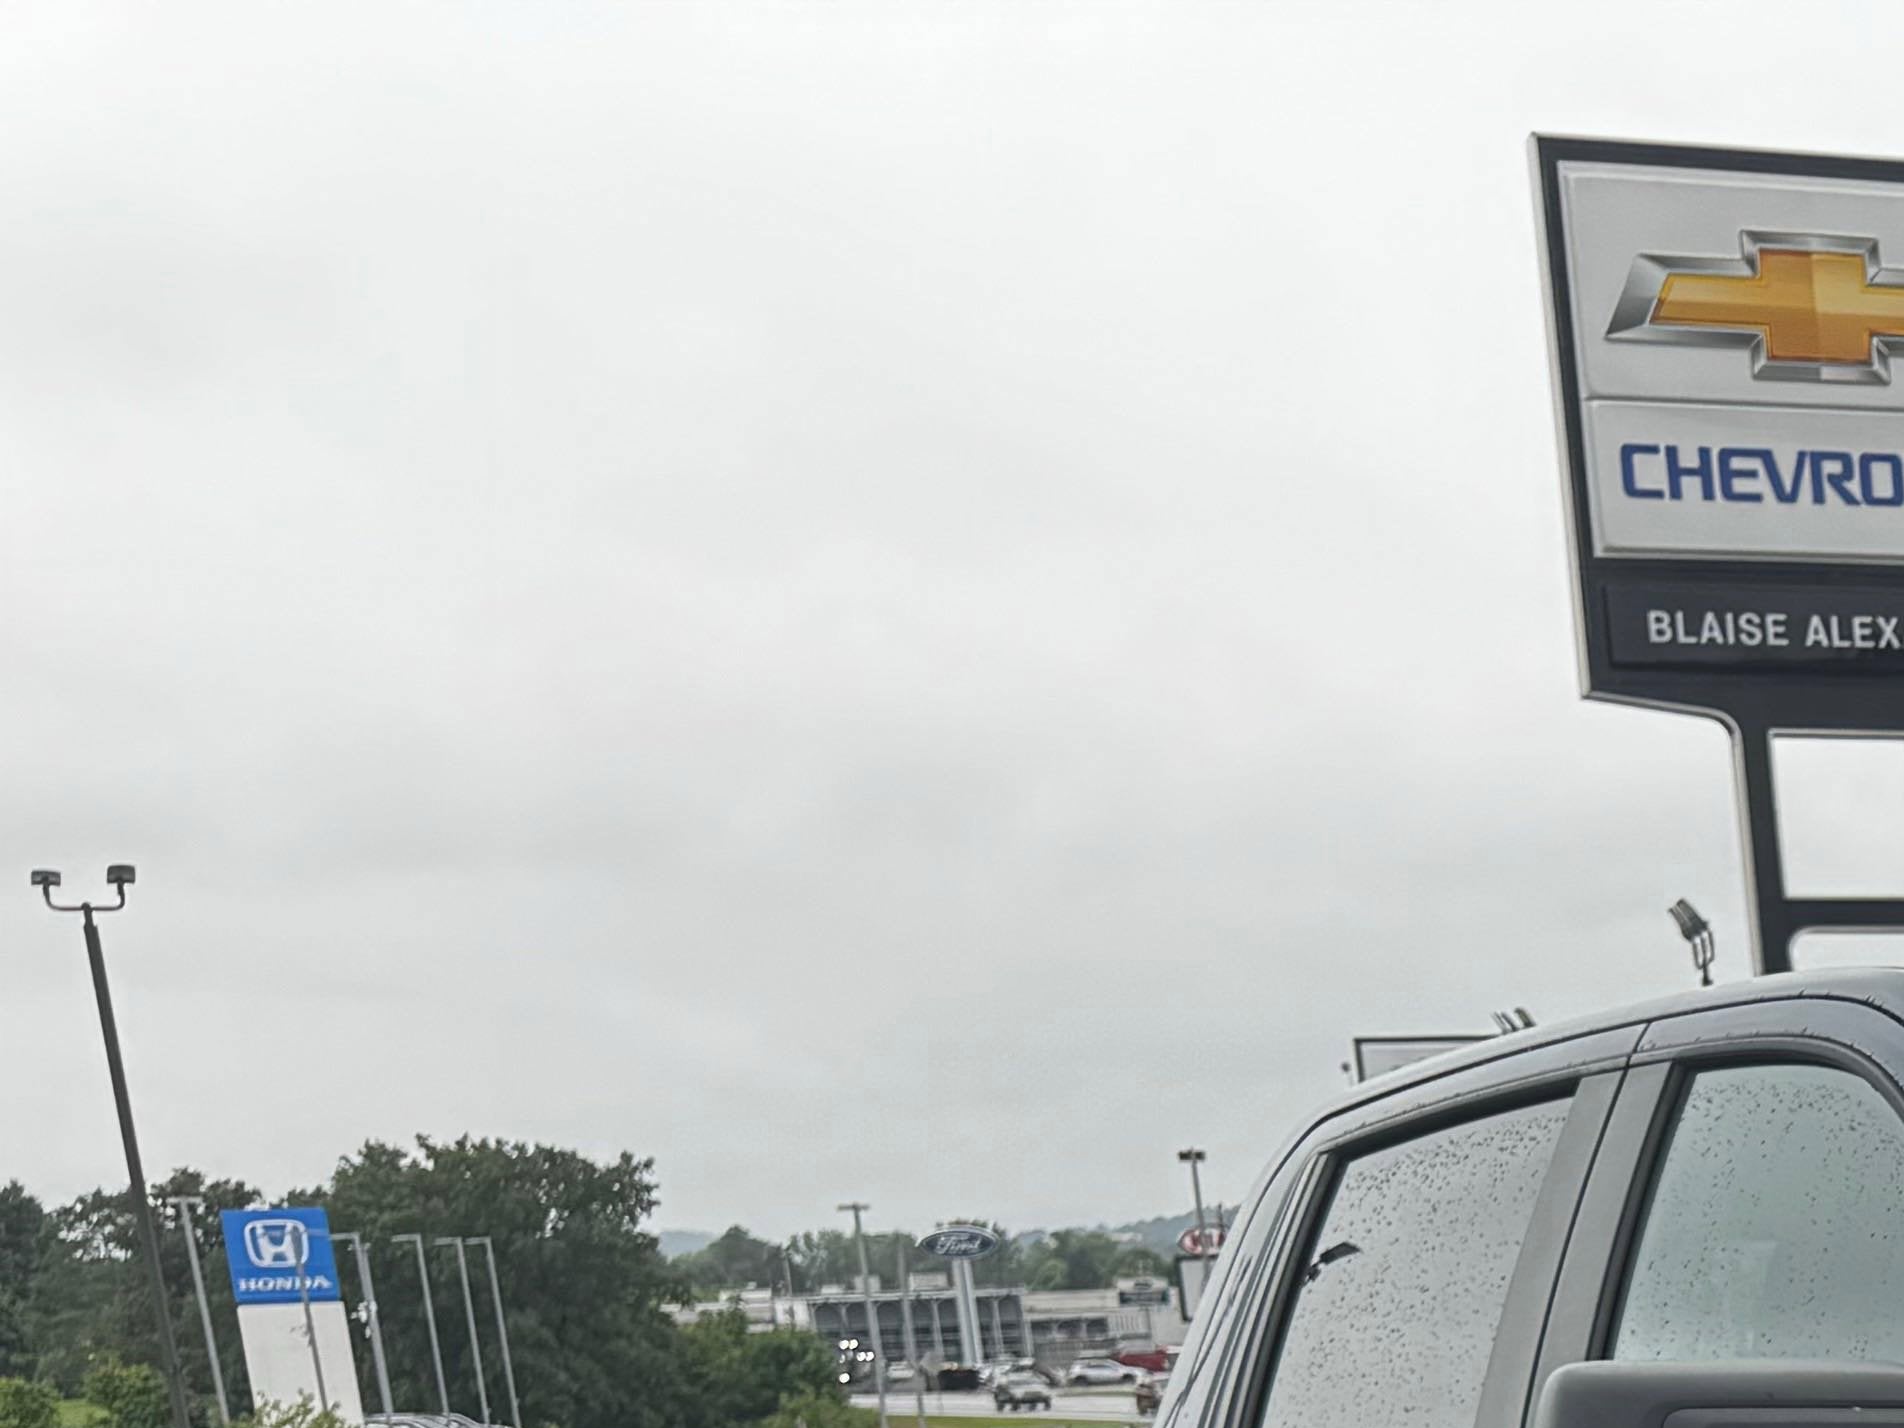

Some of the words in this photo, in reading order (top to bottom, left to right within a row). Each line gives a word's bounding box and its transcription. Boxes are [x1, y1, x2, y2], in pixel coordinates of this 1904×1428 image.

[1646, 610, 1789, 648] BLAISE
[935, 1232, 982, 1255] Ford
[238, 1275, 333, 1292] HONDA
